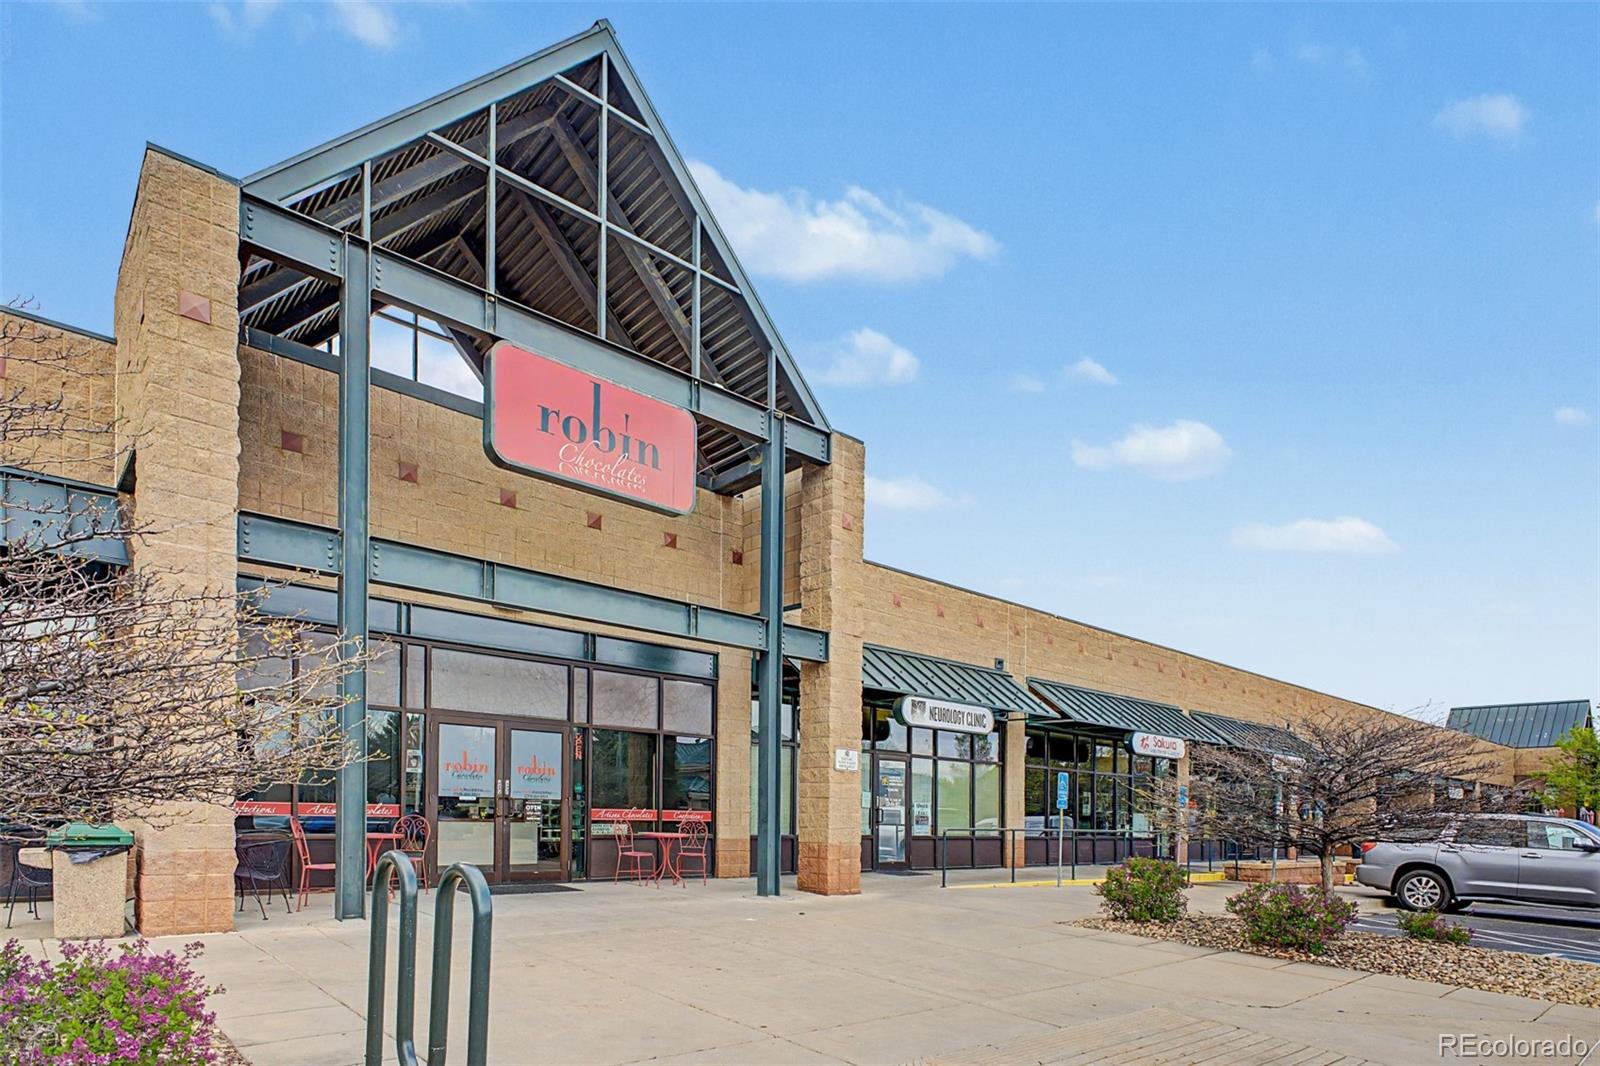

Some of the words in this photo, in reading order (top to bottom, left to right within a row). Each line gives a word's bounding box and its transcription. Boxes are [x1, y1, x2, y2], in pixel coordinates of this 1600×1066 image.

[536, 380, 662, 471] robin
[558, 440, 647, 486] Chocolates
[929, 706, 966, 725] NEUROLOGY
[966, 712, 987, 729] CLINIC
[1152, 736, 1177, 750] Sakura
[443, 750, 488, 773] robin
[516, 754, 556, 776] robin
